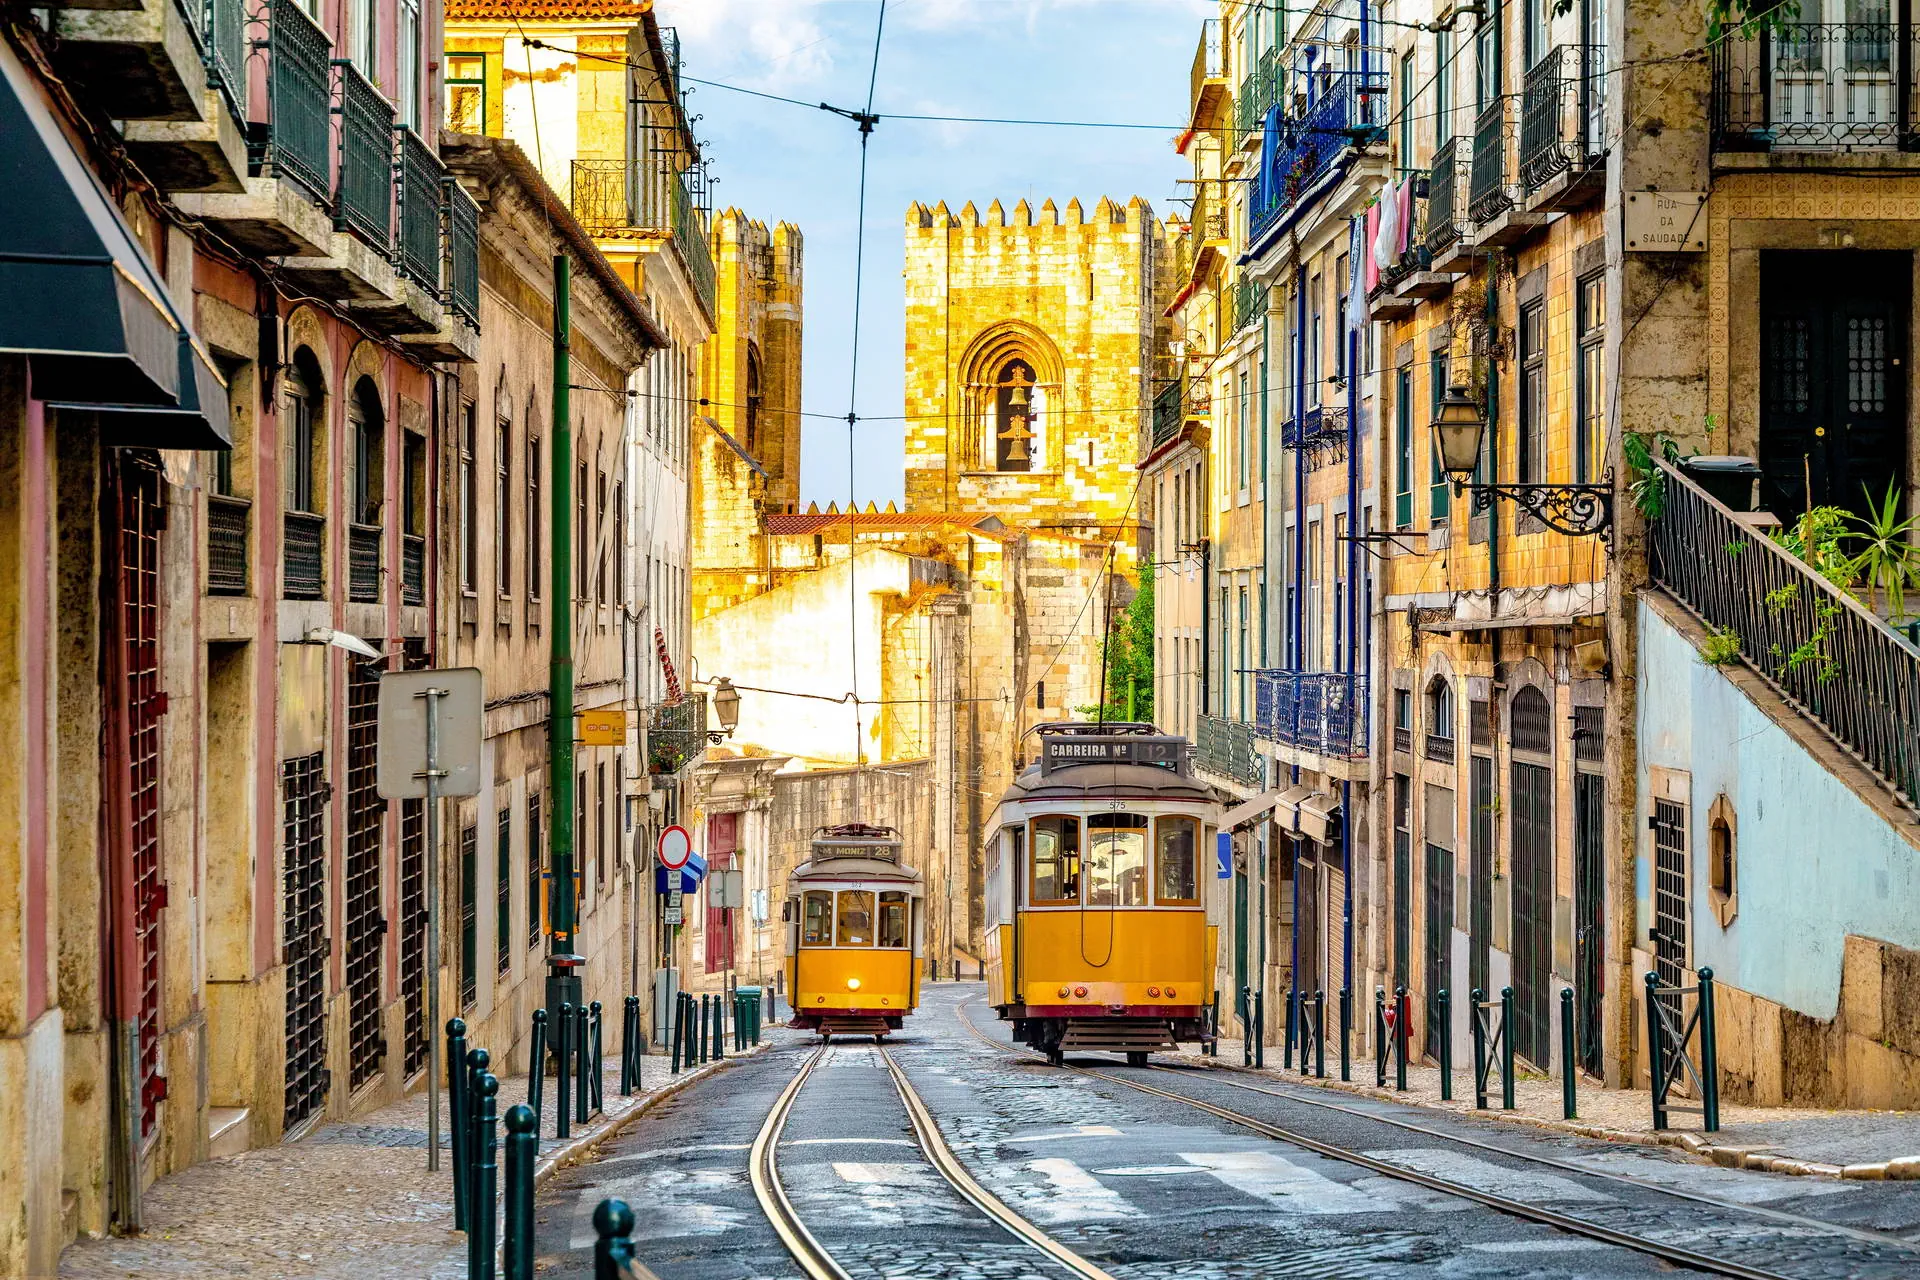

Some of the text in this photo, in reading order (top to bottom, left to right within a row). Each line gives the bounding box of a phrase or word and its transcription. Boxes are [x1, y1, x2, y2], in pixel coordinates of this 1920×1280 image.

[1657, 199, 1677, 209] RUA
[1660, 217, 1673, 226] DA
[1642, 233, 1690, 243] SAUDADE
[1051, 744, 1107, 757] CARREIRA
[1148, 744, 1167, 760] 12
[1109, 801, 1126, 810] 575
[836, 847, 866, 855] MONIZ
[874, 846, 890, 856] 28
